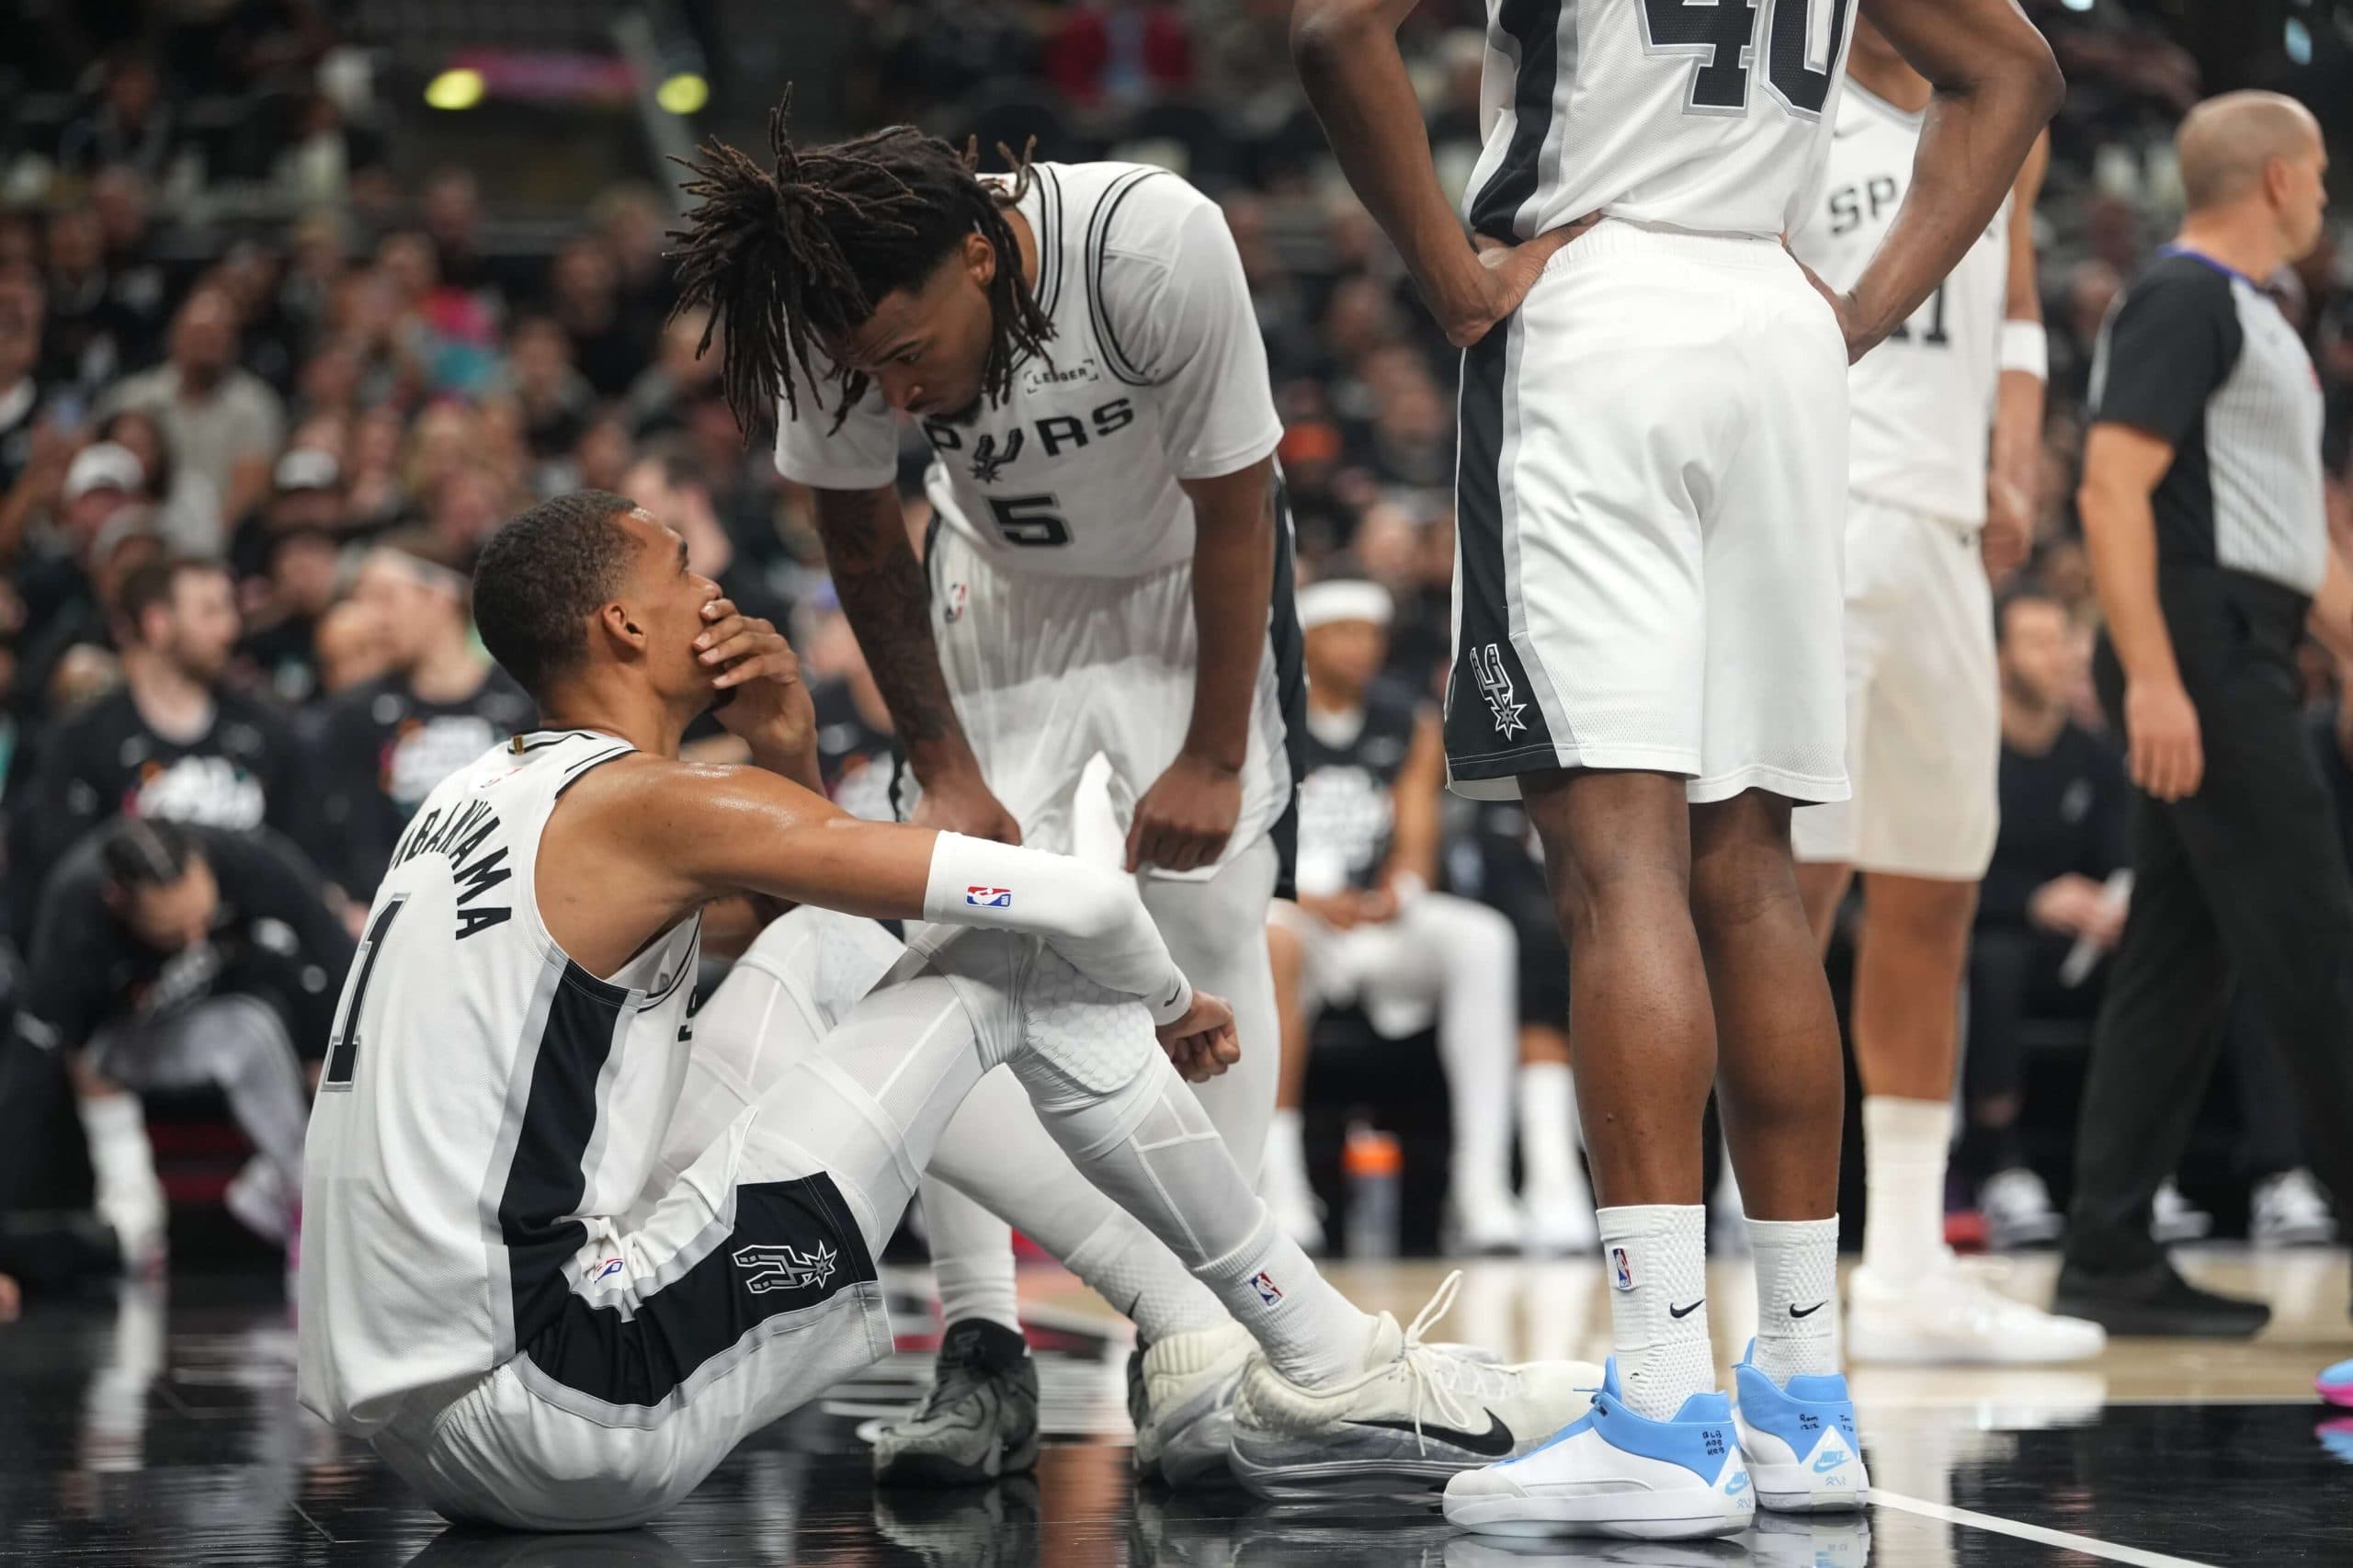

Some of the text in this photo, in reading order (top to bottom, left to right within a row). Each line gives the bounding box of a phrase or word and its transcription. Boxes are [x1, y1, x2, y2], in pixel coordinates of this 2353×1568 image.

[923, 397, 1134, 483] PURS
[987, 495, 1071, 546] 5
[392, 799, 512, 940] BANYAMA
[322, 893, 411, 1092] 1
